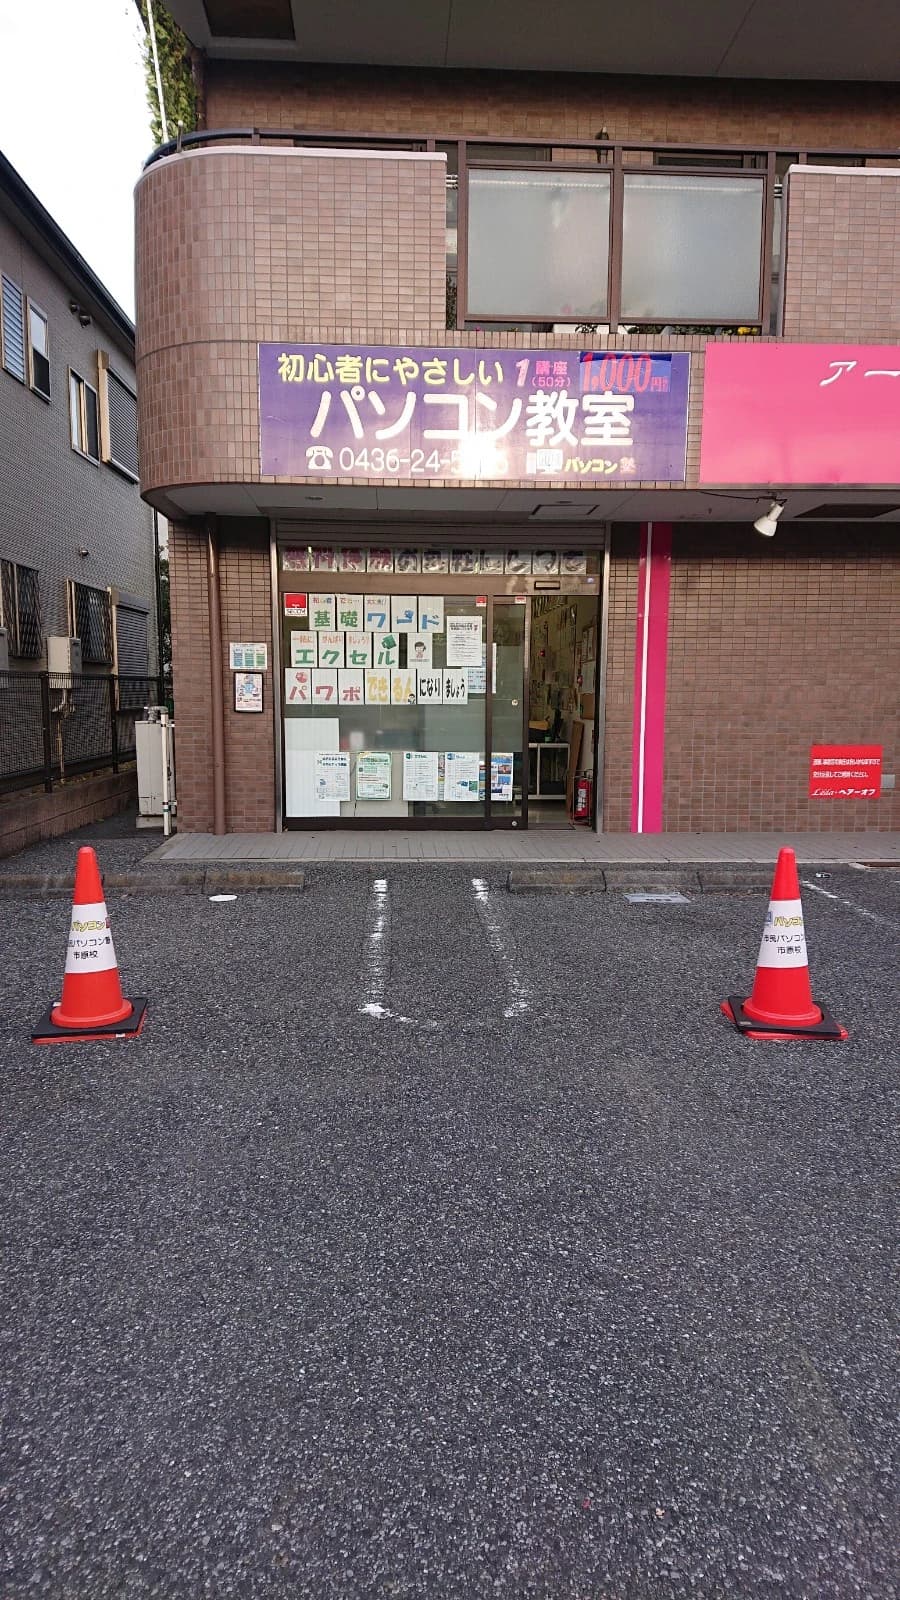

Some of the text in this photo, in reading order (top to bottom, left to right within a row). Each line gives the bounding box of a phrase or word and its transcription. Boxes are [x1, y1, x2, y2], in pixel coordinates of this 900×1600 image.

[277, 352, 504, 385] 初心者にやさしい
[515, 358, 568, 387] 1 講座
[310, 389, 635, 448] パソコン教室
[295, 649, 396, 665] エクセル
